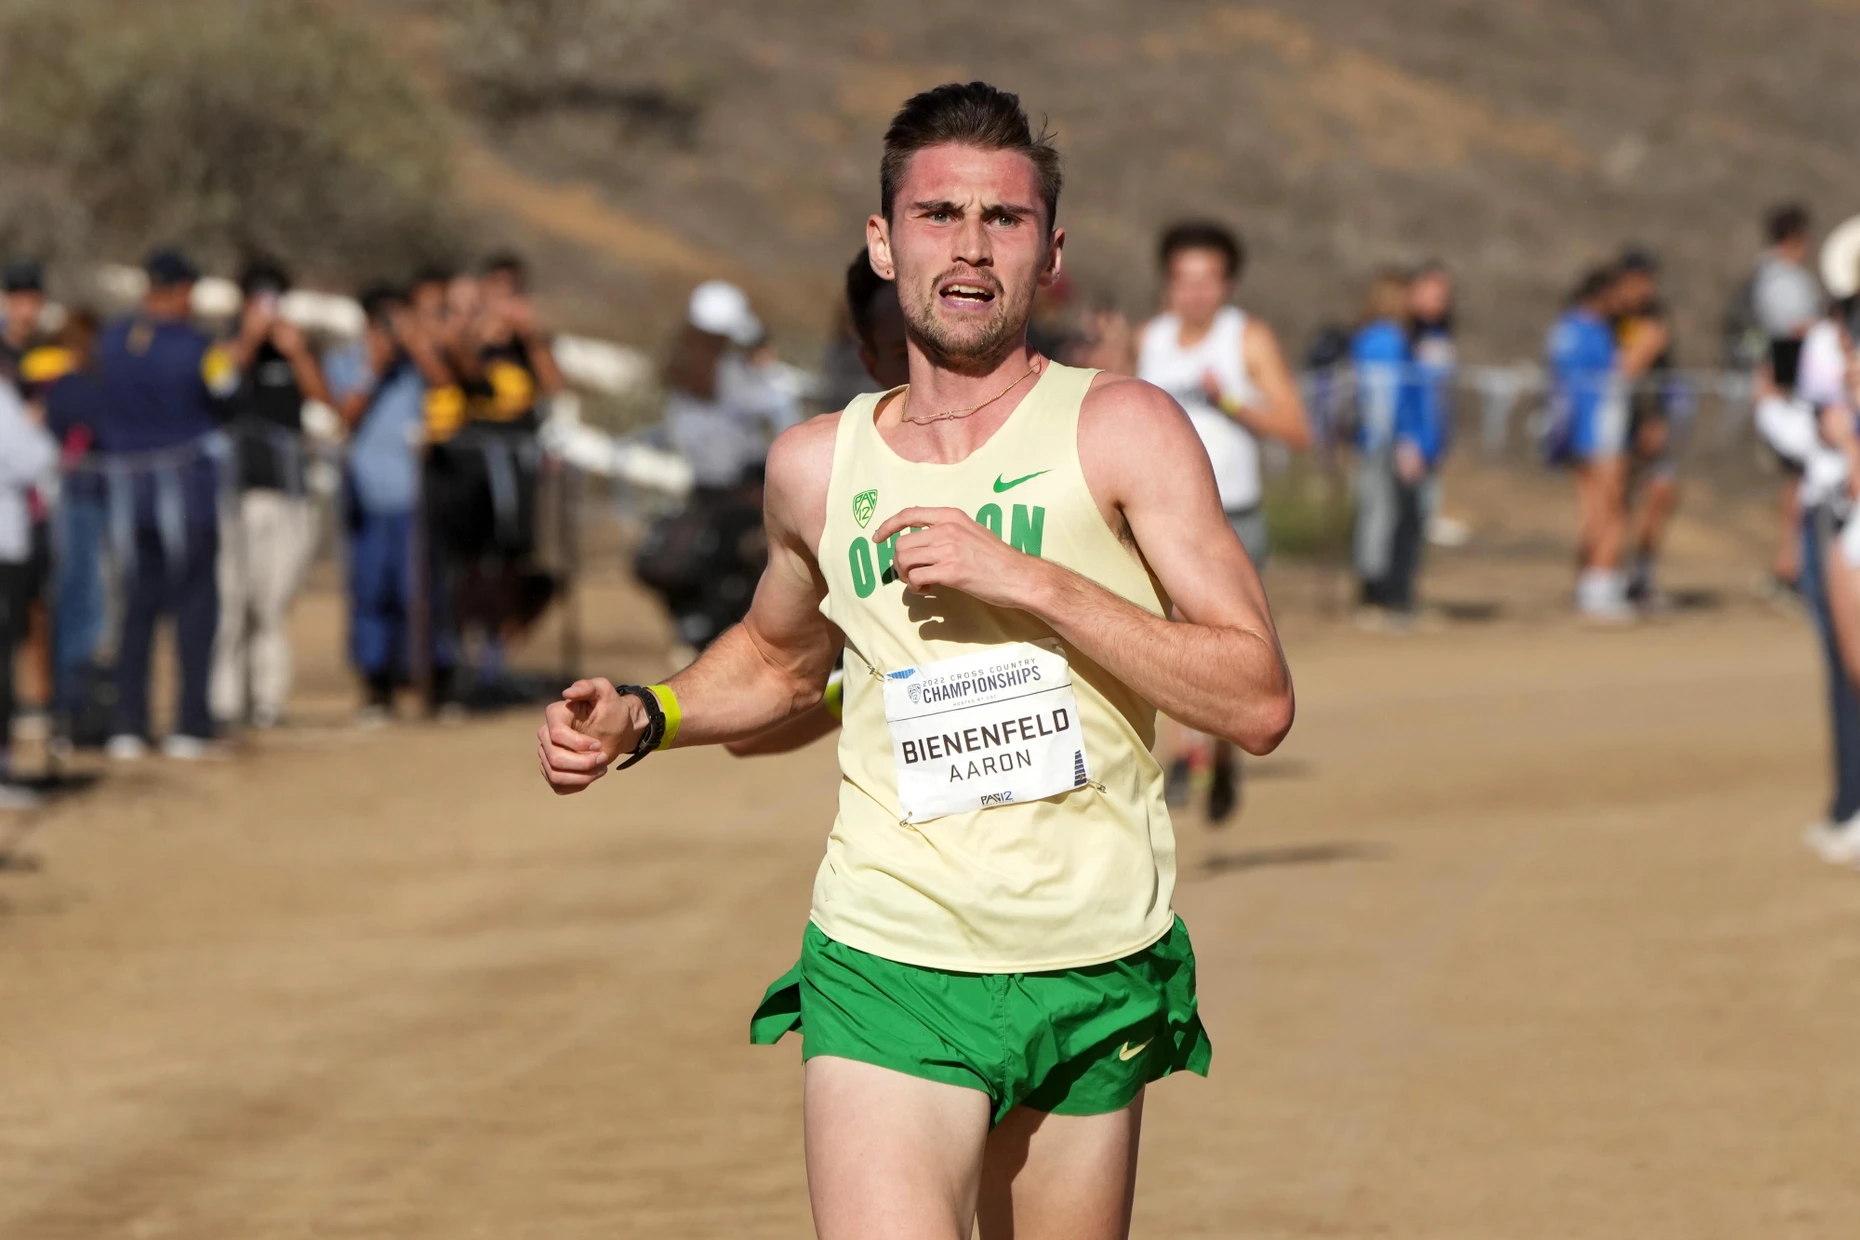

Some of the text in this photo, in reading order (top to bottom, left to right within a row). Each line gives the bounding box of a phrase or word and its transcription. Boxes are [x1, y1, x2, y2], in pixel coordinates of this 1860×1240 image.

[854, 491, 876, 515] PAC
[859, 506, 870, 521] 12
[922, 657, 1036, 687] 2022 CROSS COUNTRY
[922, 665, 1042, 704] CHAMPIONSHIPS
[901, 707, 1070, 764] BIENENFELD
[949, 748, 1033, 783] AARON
